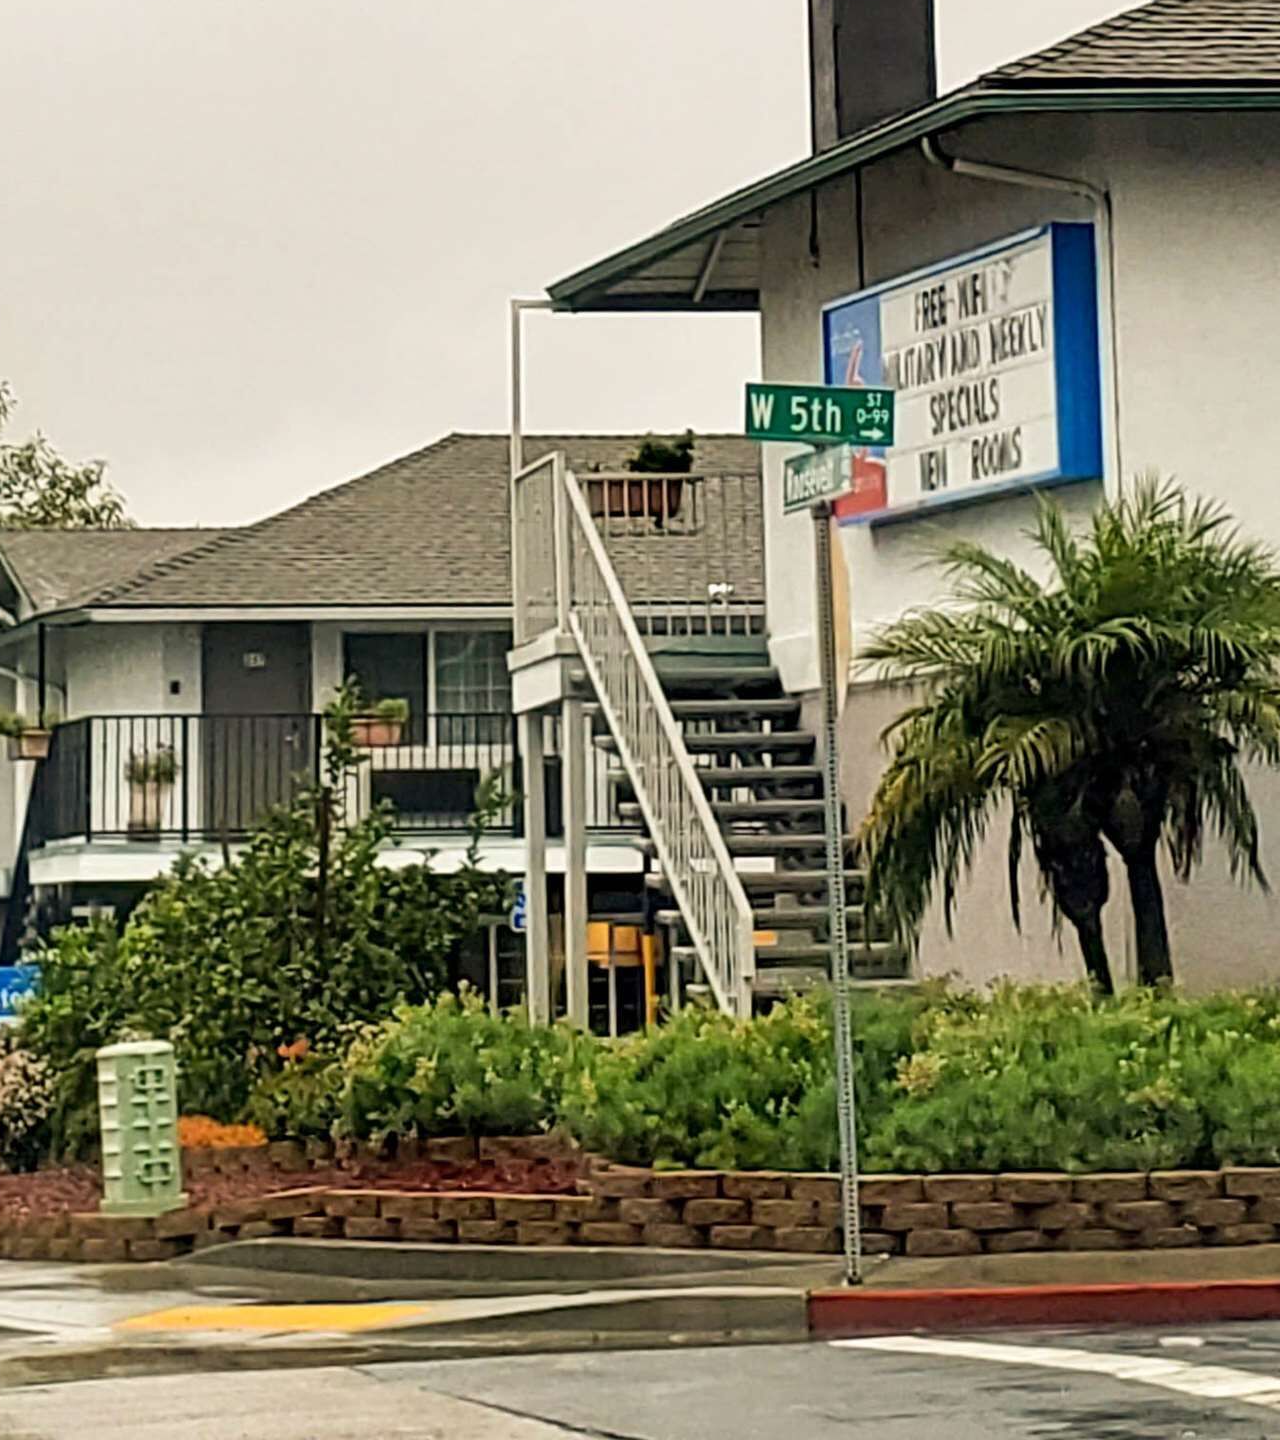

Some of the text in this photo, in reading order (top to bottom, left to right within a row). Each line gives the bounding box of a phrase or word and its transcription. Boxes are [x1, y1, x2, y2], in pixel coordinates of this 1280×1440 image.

[914, 284, 948, 333] FREE
[750, 392, 842, 433] W 5th
[866, 392, 883, 408] ST
[930, 378, 1000, 436] SPECIALS
